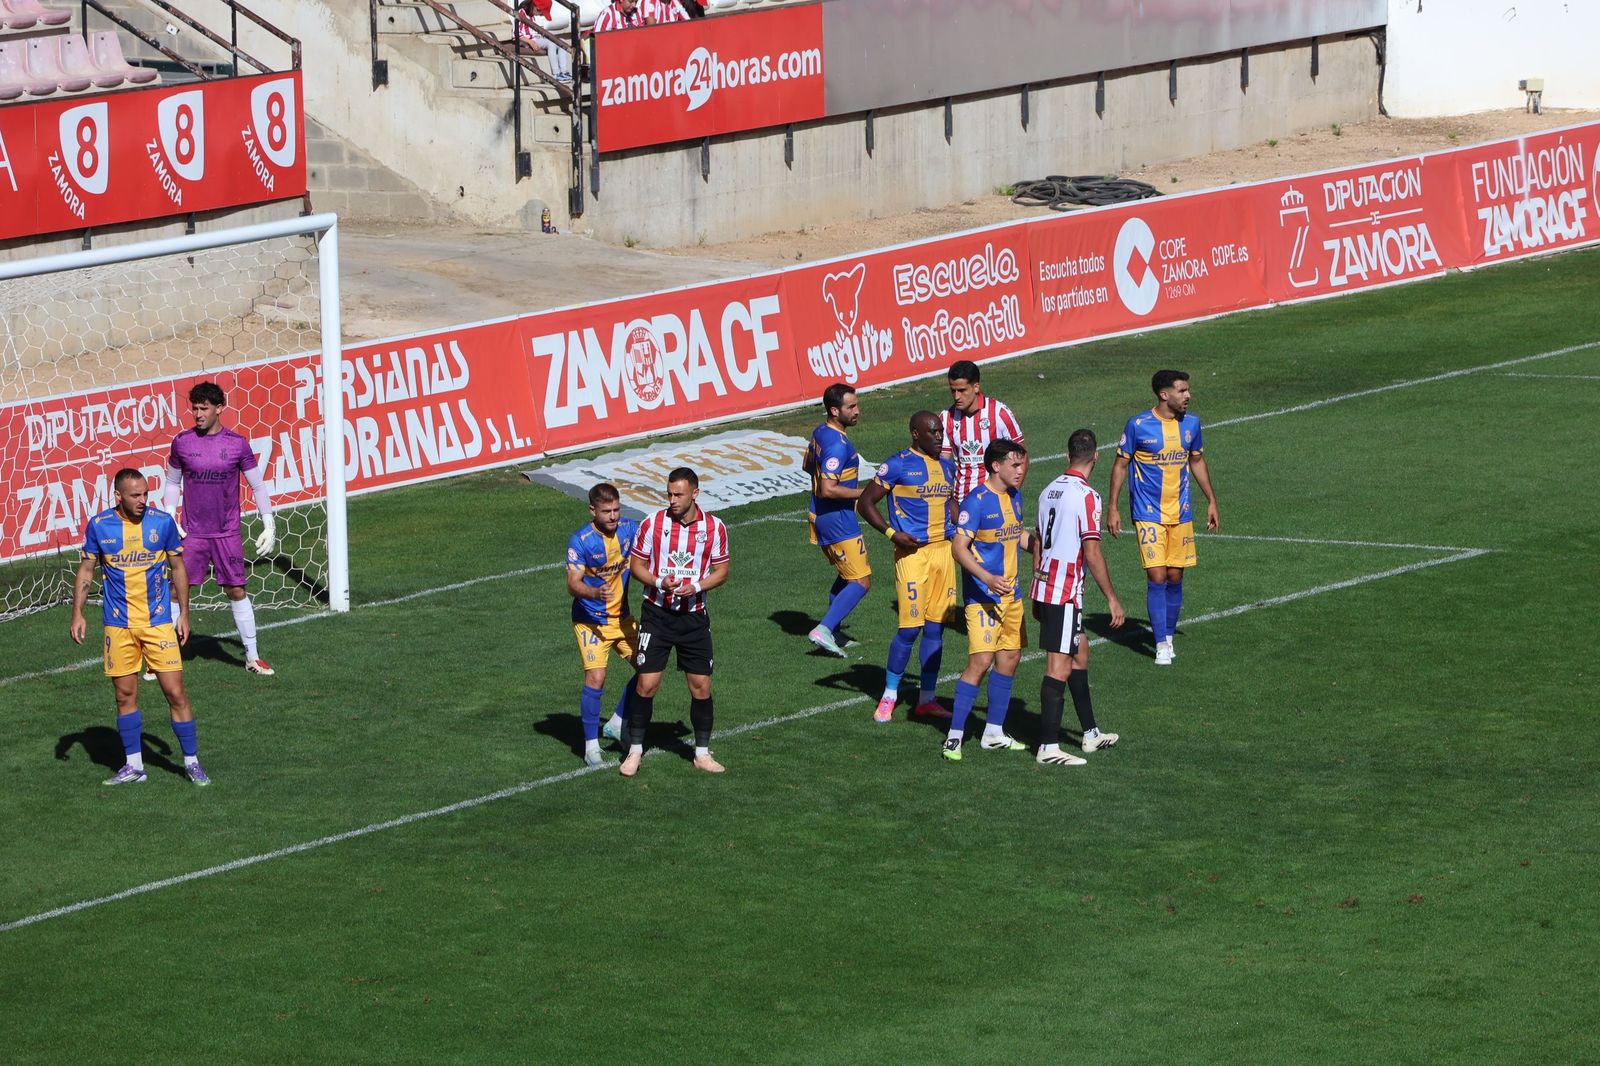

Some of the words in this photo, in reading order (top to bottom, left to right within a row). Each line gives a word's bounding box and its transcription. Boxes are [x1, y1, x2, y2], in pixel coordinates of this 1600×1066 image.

[601, 47, 822, 107] zamora24horas.com
[76, 115, 99, 178] 8
[175, 103, 195, 165] 8
[266, 91, 287, 152] 8
[48, 150, 86, 220] ZAMORA
[146, 138, 182, 206] ZAMORA
[241, 125, 275, 192] ZAMORA
[1472, 136, 1585, 203] FUNDACIÓN
[893, 242, 1020, 306] Escuela
[1039, 256, 1078, 282] Escucha
[1077, 251, 1105, 275] todos
[1159, 237, 1188, 260] COPE
[1161, 257, 1209, 284] ZAMORA
[1211, 243, 1249, 267] COPE.es
[1323, 222, 1443, 287] ZAMORA
[901, 294, 1025, 363] infantil
[1041, 291, 1056, 313] los
[1057, 288, 1096, 315] partidos
[1095, 286, 1109, 303] en
[531, 308, 728, 429] ZAMORA
[720, 294, 781, 392] CF
[1139, 527, 1158, 545] 23
[677, 569, 699, 577] RURAL
[907, 581, 918, 601] 5
[105, 635, 111, 653] 9
[580, 630, 599, 647] 14
[638, 632, 651, 651] 14
